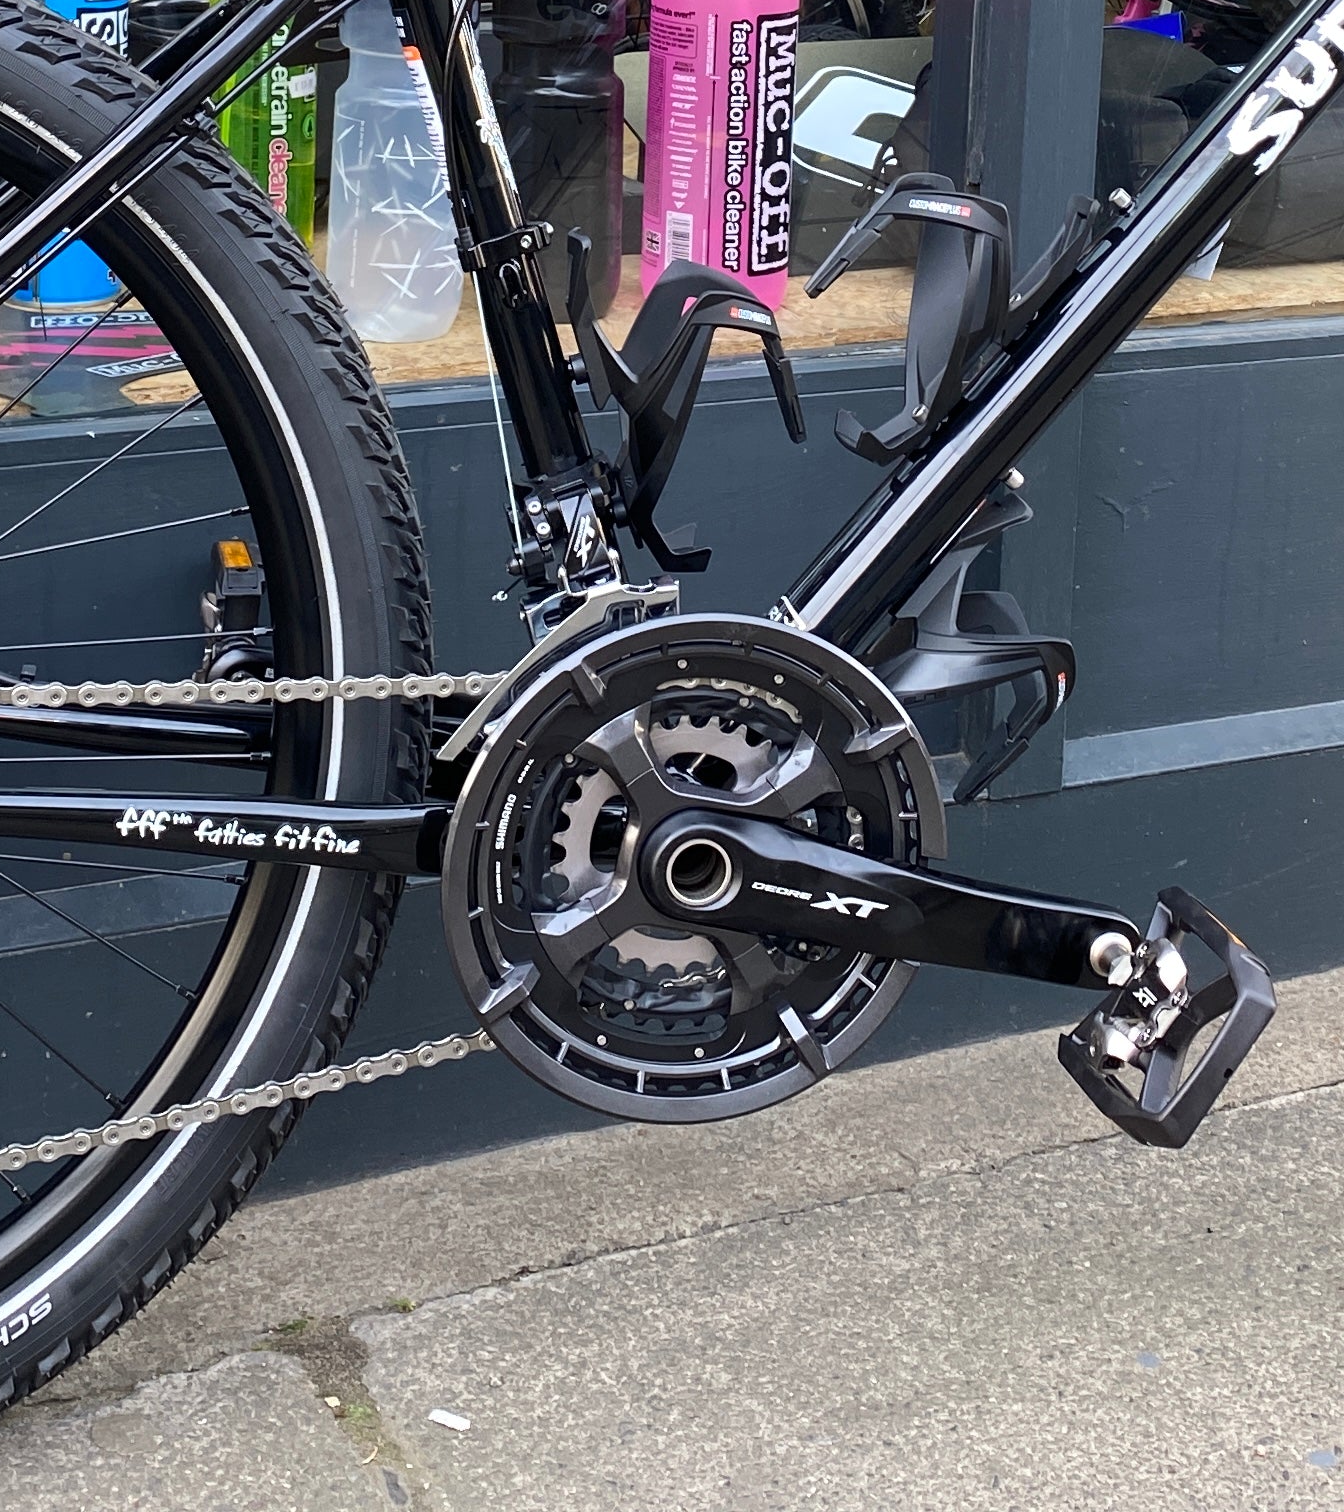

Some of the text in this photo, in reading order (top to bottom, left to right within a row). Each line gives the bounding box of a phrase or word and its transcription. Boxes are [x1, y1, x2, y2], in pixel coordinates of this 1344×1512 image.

[722, 21, 753, 271] fast action bike cleaner
[269, 138, 293, 216] cleane
[193, 817, 267, 847] fatties
[494, 793, 517, 851] SHIMANO
[751, 881, 890, 920] DEORE XT
